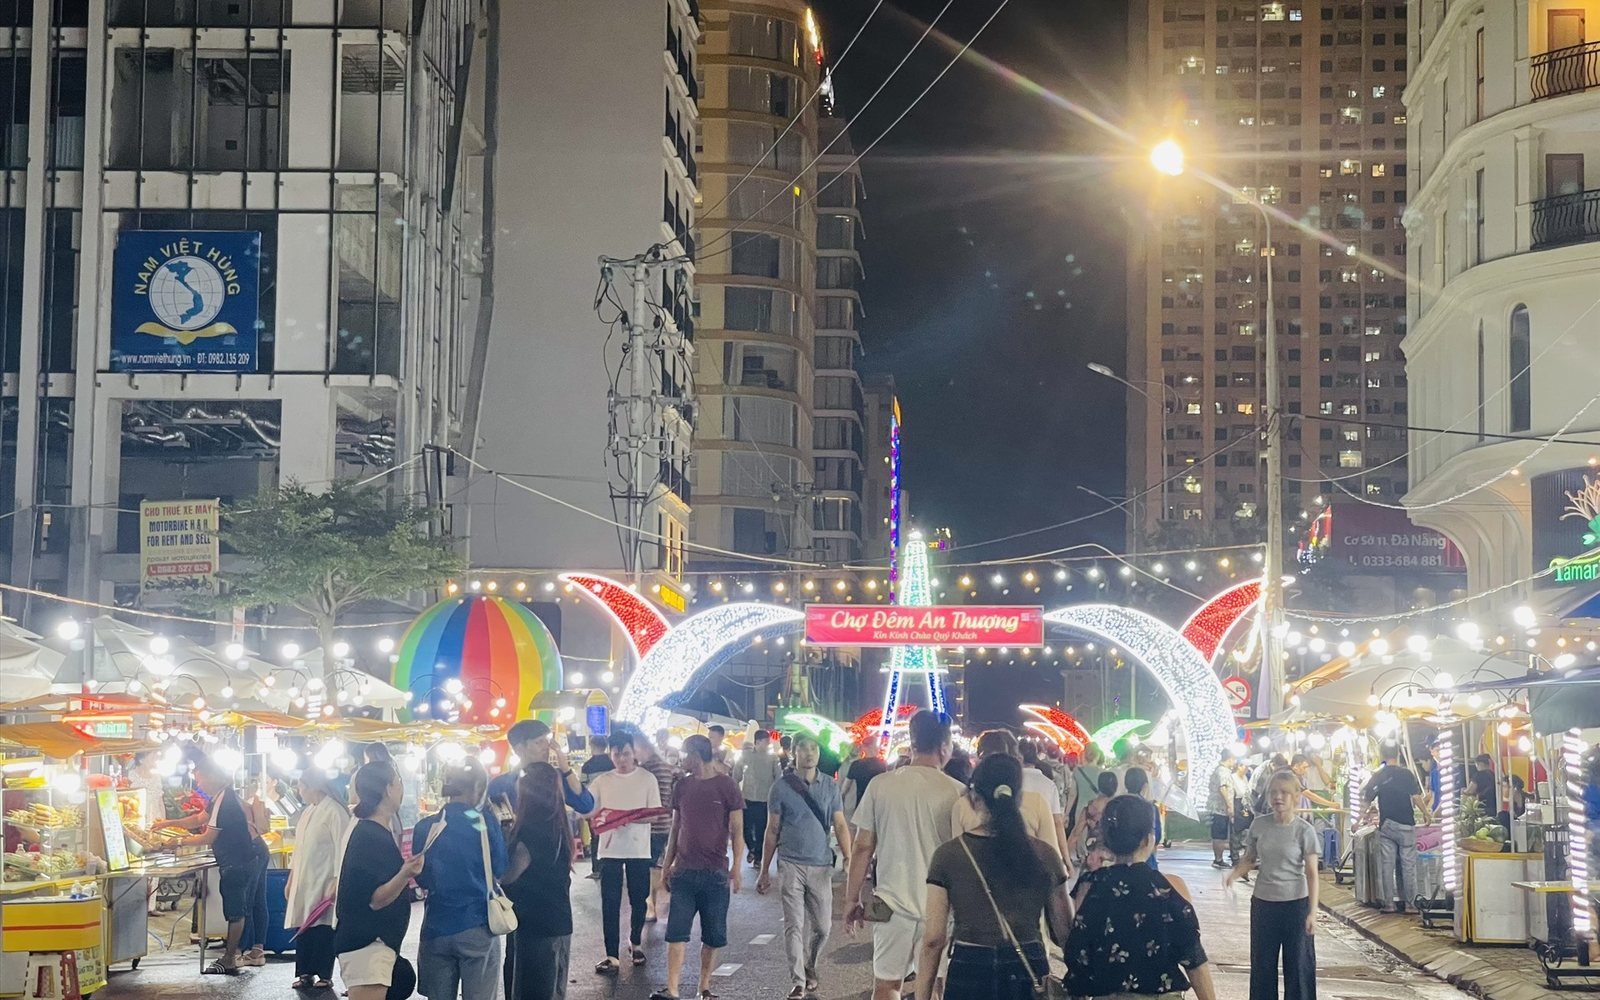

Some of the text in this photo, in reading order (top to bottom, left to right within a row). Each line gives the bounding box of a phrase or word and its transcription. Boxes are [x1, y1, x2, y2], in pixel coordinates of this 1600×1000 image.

[134, 238, 241, 296] NAM VIỆT HÙNG
[121, 352, 191, 367] www.namviethung.vn
[238, 353, 250, 364] 209
[144, 507, 160, 517] CHO
[183, 505, 193, 515] XE
[149, 520, 188, 532] MOTORBIKE
[190, 518, 195, 531] H
[147, 533, 211, 547] FOR RENT AND SELL
[1390, 533, 1410, 546] Đà
[1411, 532, 1447, 550] Nẵng
[1554, 566, 1600, 582] Tamar
[831, 610, 868, 632] Chợ
[872, 609, 915, 630] Đêm
[918, 610, 946, 630] An
[952, 610, 1019, 632] Thượng
[873, 630, 887, 640] Xin
[933, 630, 950, 642] Quý
[951, 630, 978, 640] Khách
